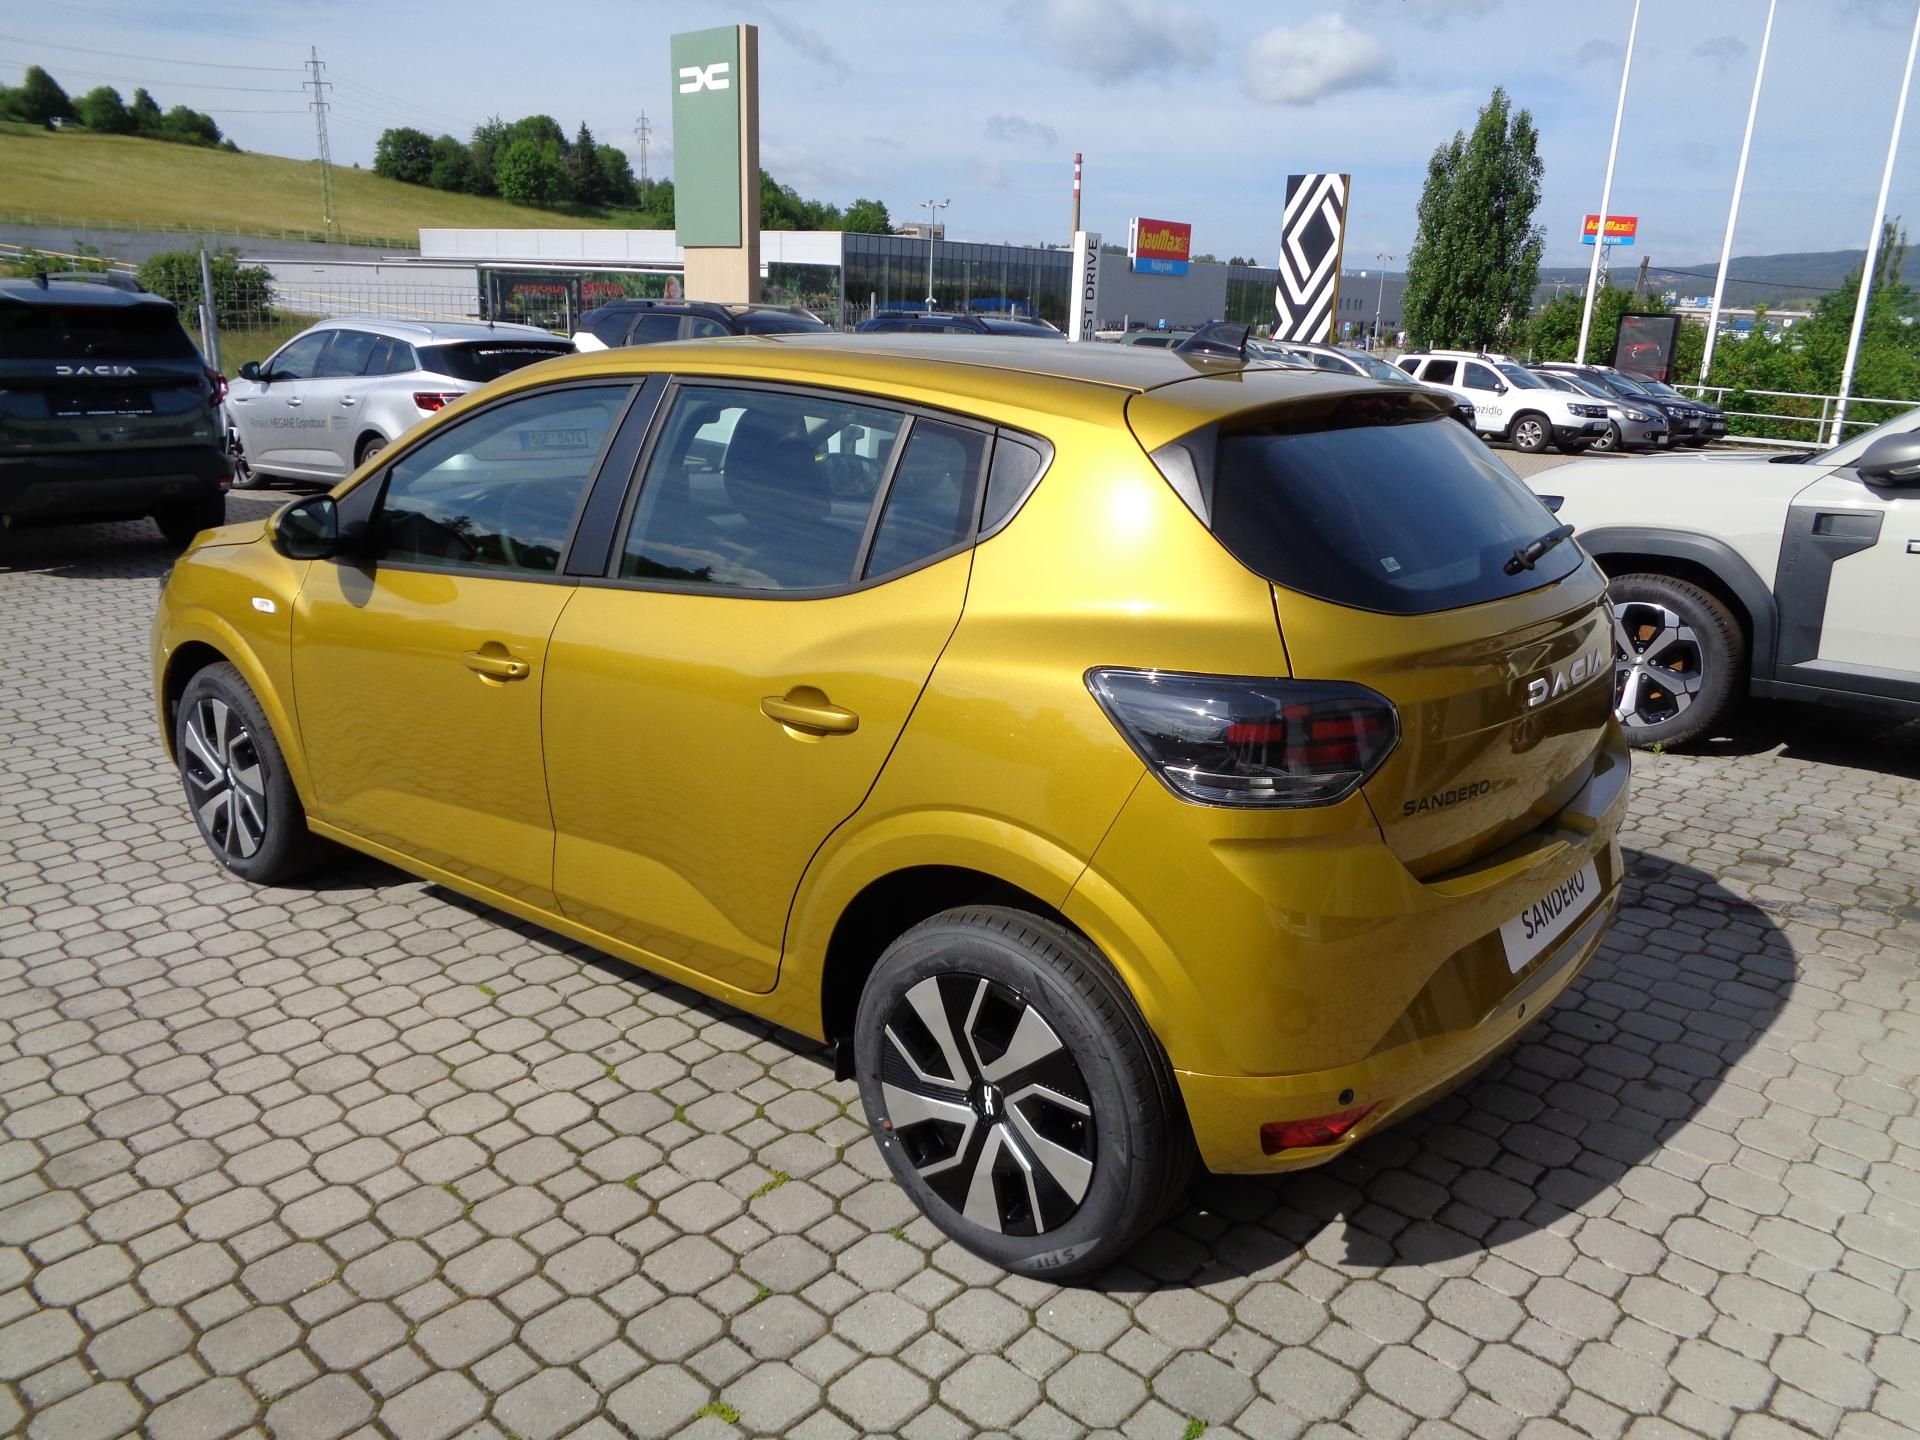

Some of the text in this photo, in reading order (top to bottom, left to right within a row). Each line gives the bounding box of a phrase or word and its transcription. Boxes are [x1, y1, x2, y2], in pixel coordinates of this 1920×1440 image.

[1082, 238, 1098, 341] EST DRIVE
[56, 366, 138, 375] DACIA
[1474, 405, 1503, 416] ozidlo
[1528, 647, 1602, 706] DACIA
[1403, 780, 1490, 816] SANDERO
[1522, 870, 1585, 939] SANDERO
